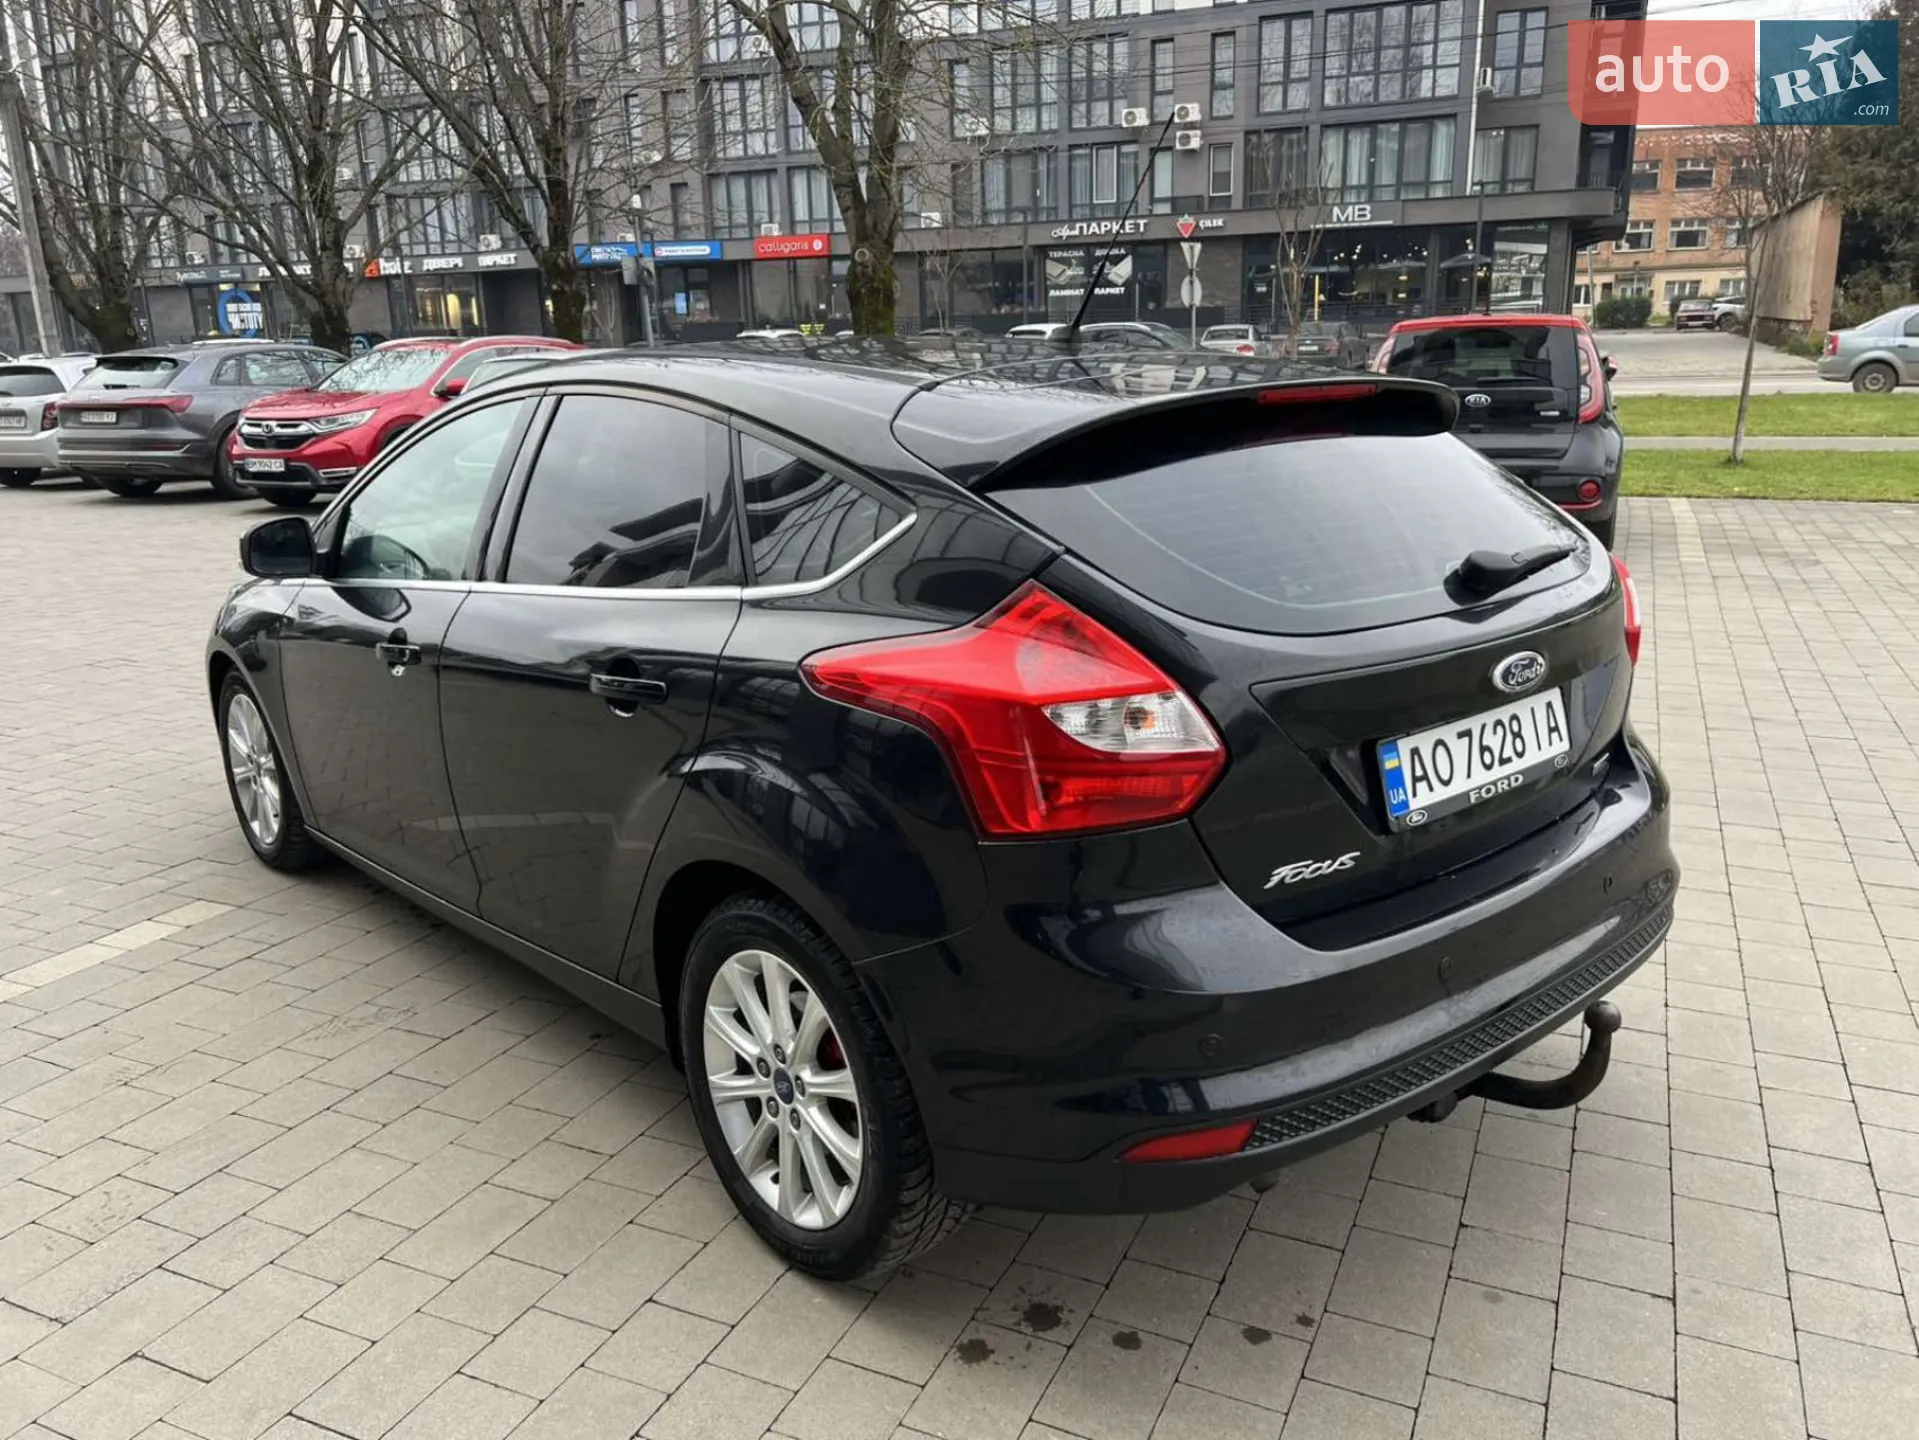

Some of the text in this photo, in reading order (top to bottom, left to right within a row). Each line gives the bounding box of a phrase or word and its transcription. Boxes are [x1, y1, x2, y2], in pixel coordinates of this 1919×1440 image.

[1332, 204, 1372, 222] MB
[1076, 219, 1148, 236] ПАРКЕТ
[1508, 659, 1544, 686] Ford
[1389, 787, 1407, 805] UA
[1468, 773, 1525, 804] FORD
[1262, 851, 1361, 890] Focus
